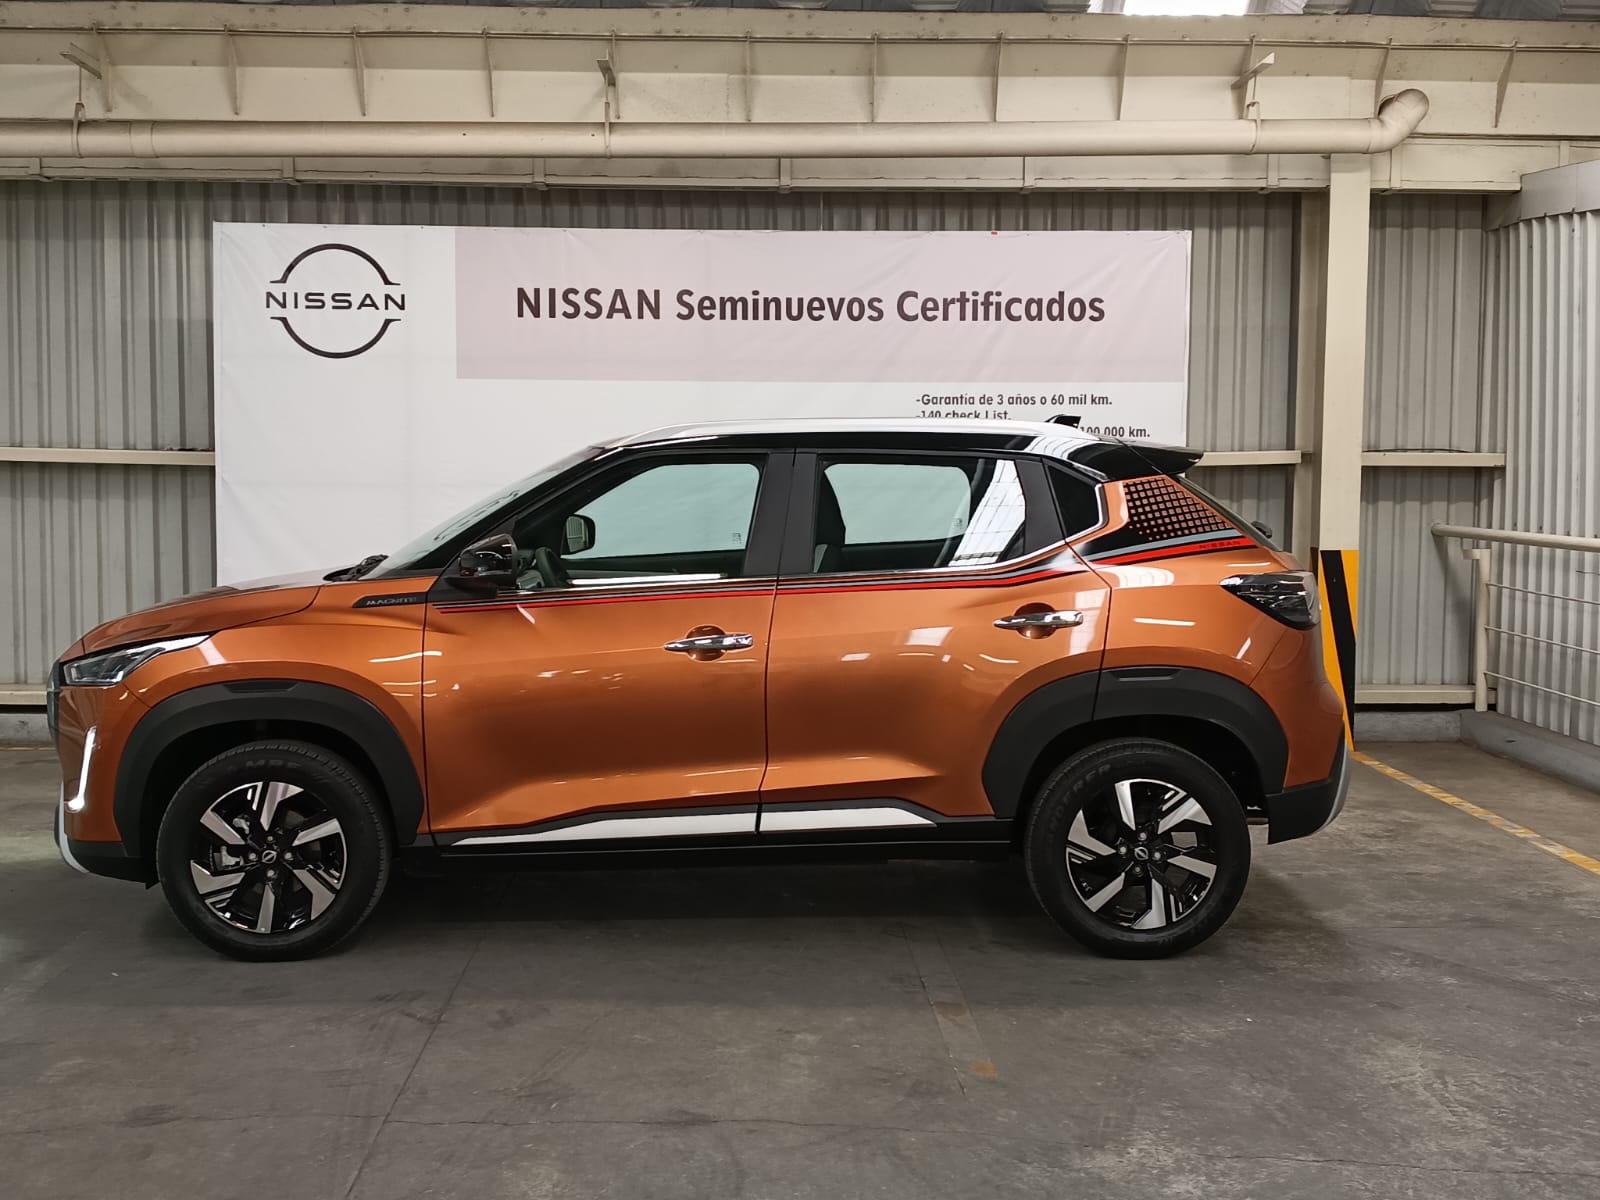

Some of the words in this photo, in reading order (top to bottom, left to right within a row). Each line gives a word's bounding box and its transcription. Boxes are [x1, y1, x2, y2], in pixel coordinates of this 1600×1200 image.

[266, 291, 405, 311] NISSAN
[516, 287, 661, 320] NISSAN
[676, 288, 884, 322] Seminuevos
[896, 290, 1105, 322] Certificados
[915, 393, 975, 406] -Garantía
[978, 393, 994, 406] de
[997, 393, 1004, 406] 3
[1007, 393, 1036, 406] años
[1040, 396, 1047, 406] o
[1050, 393, 1065, 406] 60
[1068, 393, 1087, 406] mil
[1090, 393, 1113, 406] km.
[1129, 426, 1151, 438] km.
